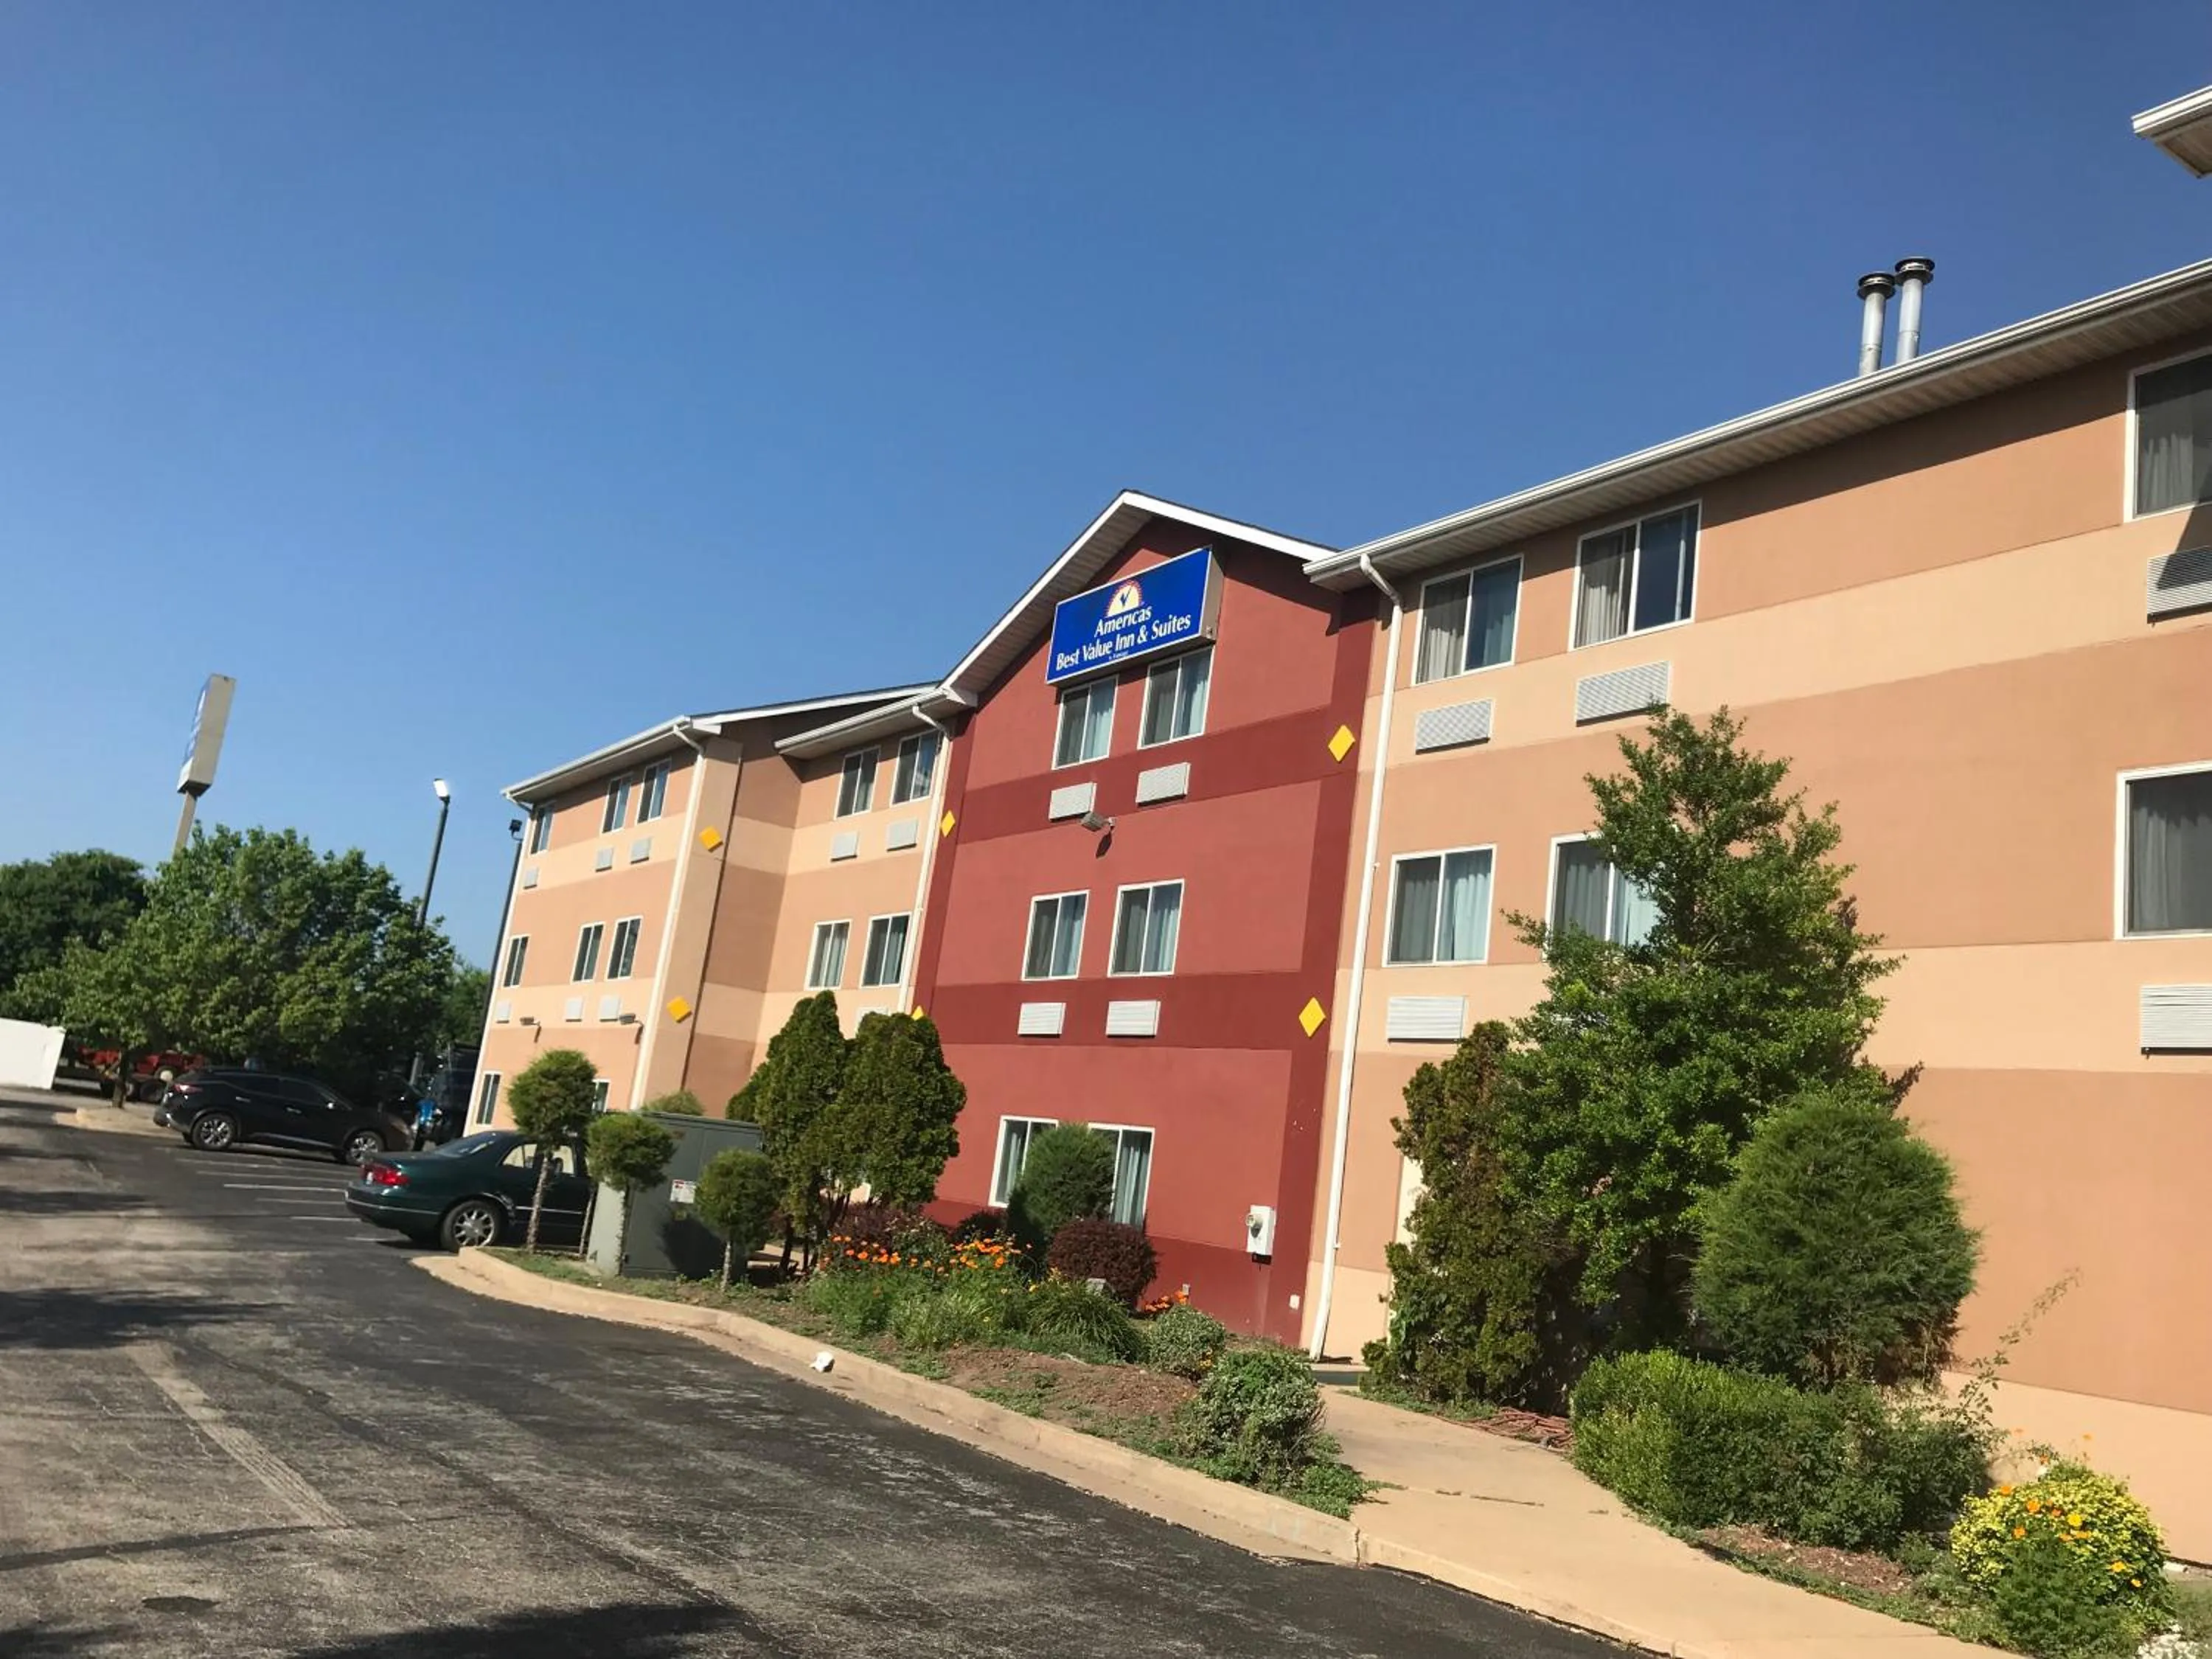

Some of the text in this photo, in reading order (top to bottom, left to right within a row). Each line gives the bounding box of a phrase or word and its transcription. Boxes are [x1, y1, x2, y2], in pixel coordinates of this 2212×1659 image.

[1056, 648, 1079, 670] Best
[1082, 639, 1113, 661] Value
[1115, 633, 1135, 651] Inn
[1137, 625, 1149, 644] &
[1151, 614, 1192, 640] Suites
[1093, 605, 1152, 638] Americas
